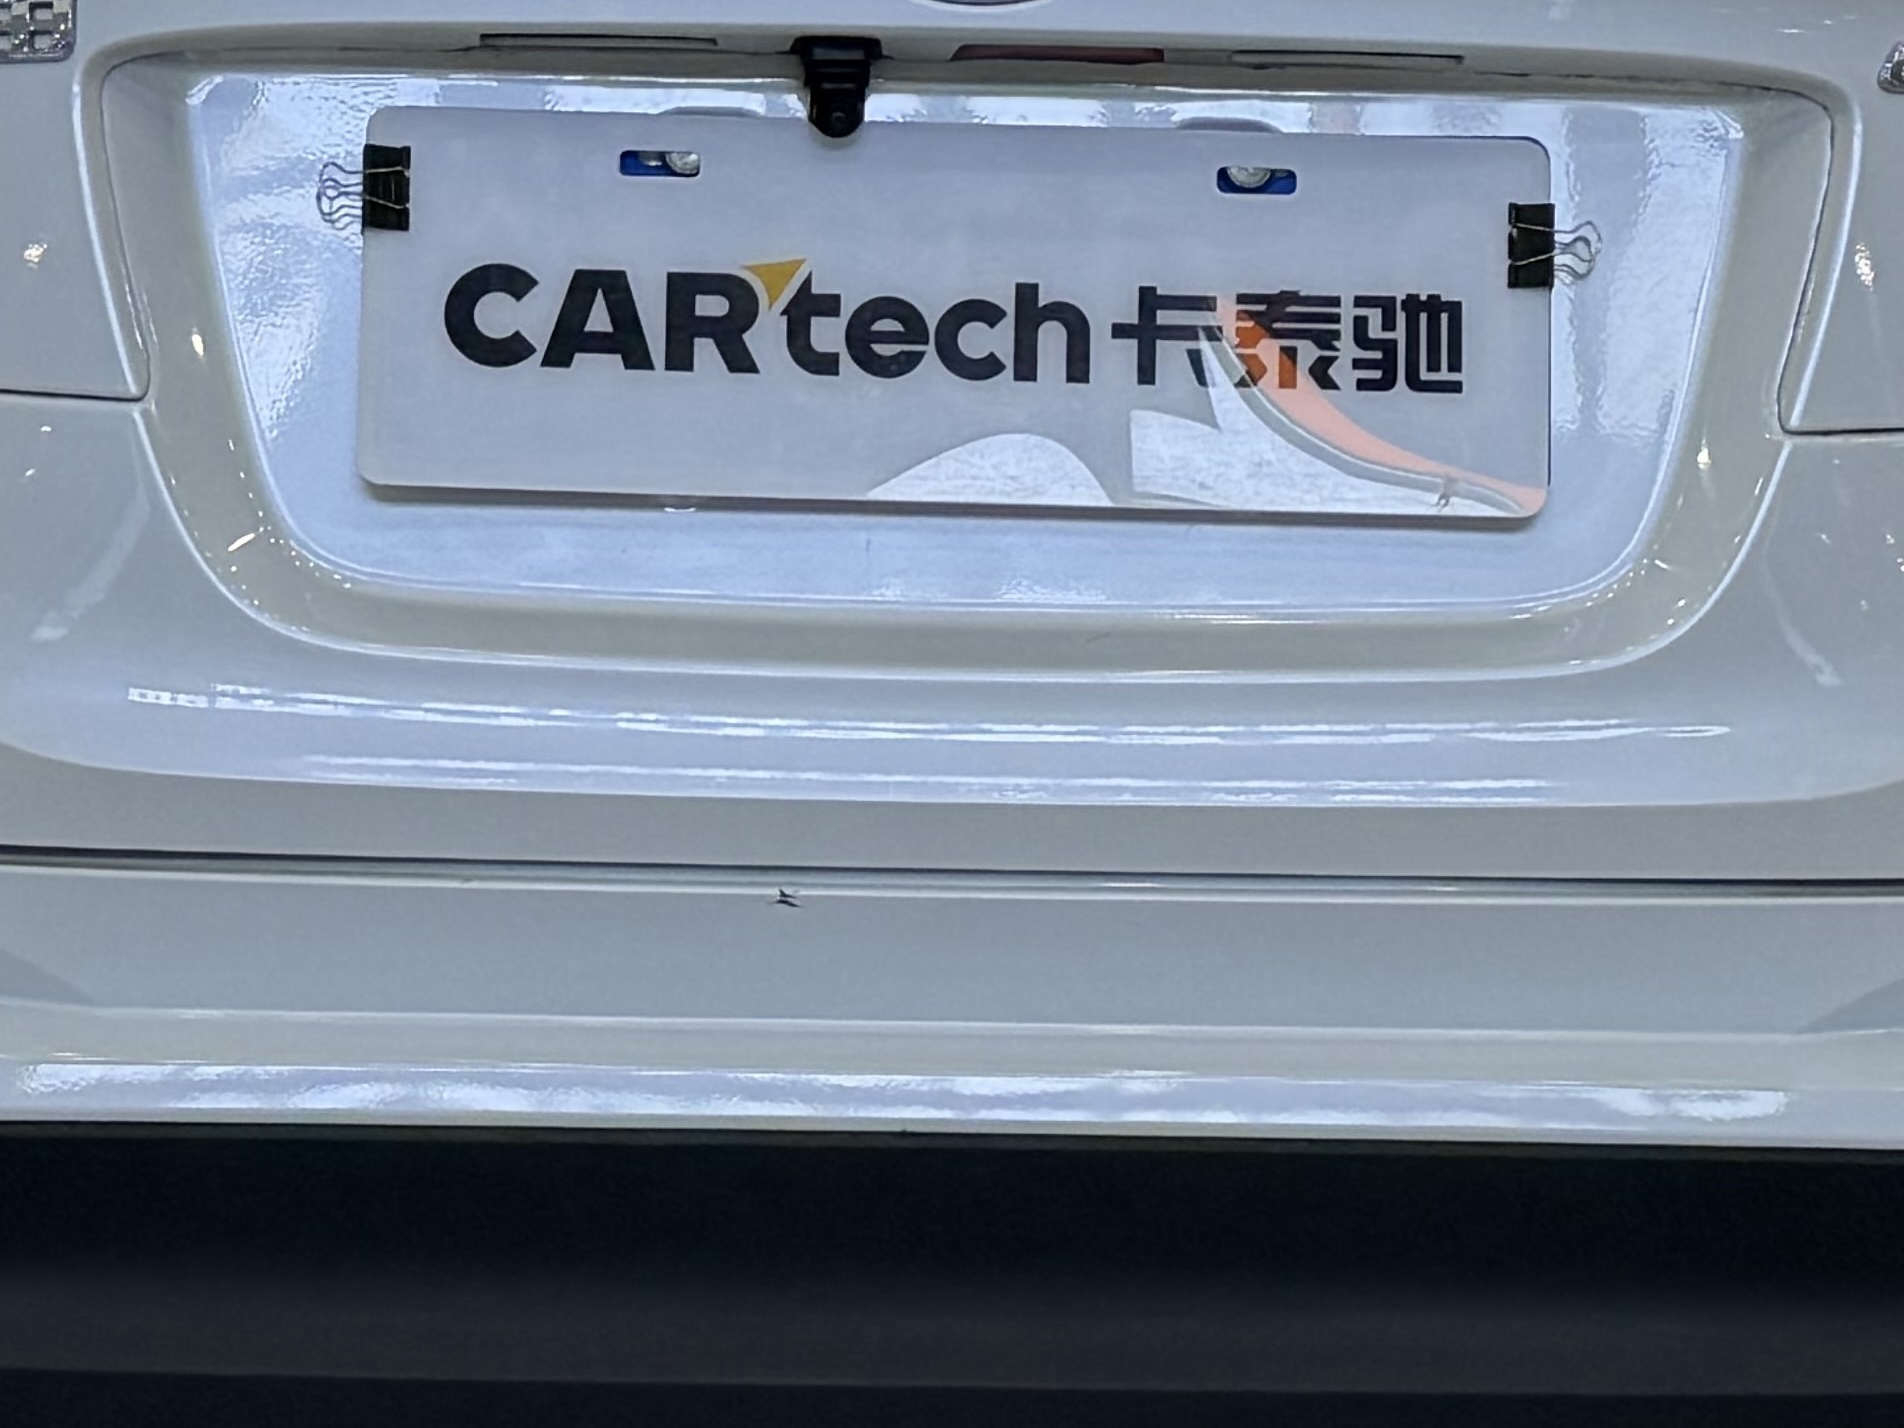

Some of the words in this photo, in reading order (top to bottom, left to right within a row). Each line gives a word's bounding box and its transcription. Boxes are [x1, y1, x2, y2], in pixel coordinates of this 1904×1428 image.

[443, 260, 1091, 385] CARtech
[1110, 284, 1464, 394] 卡泰驰
